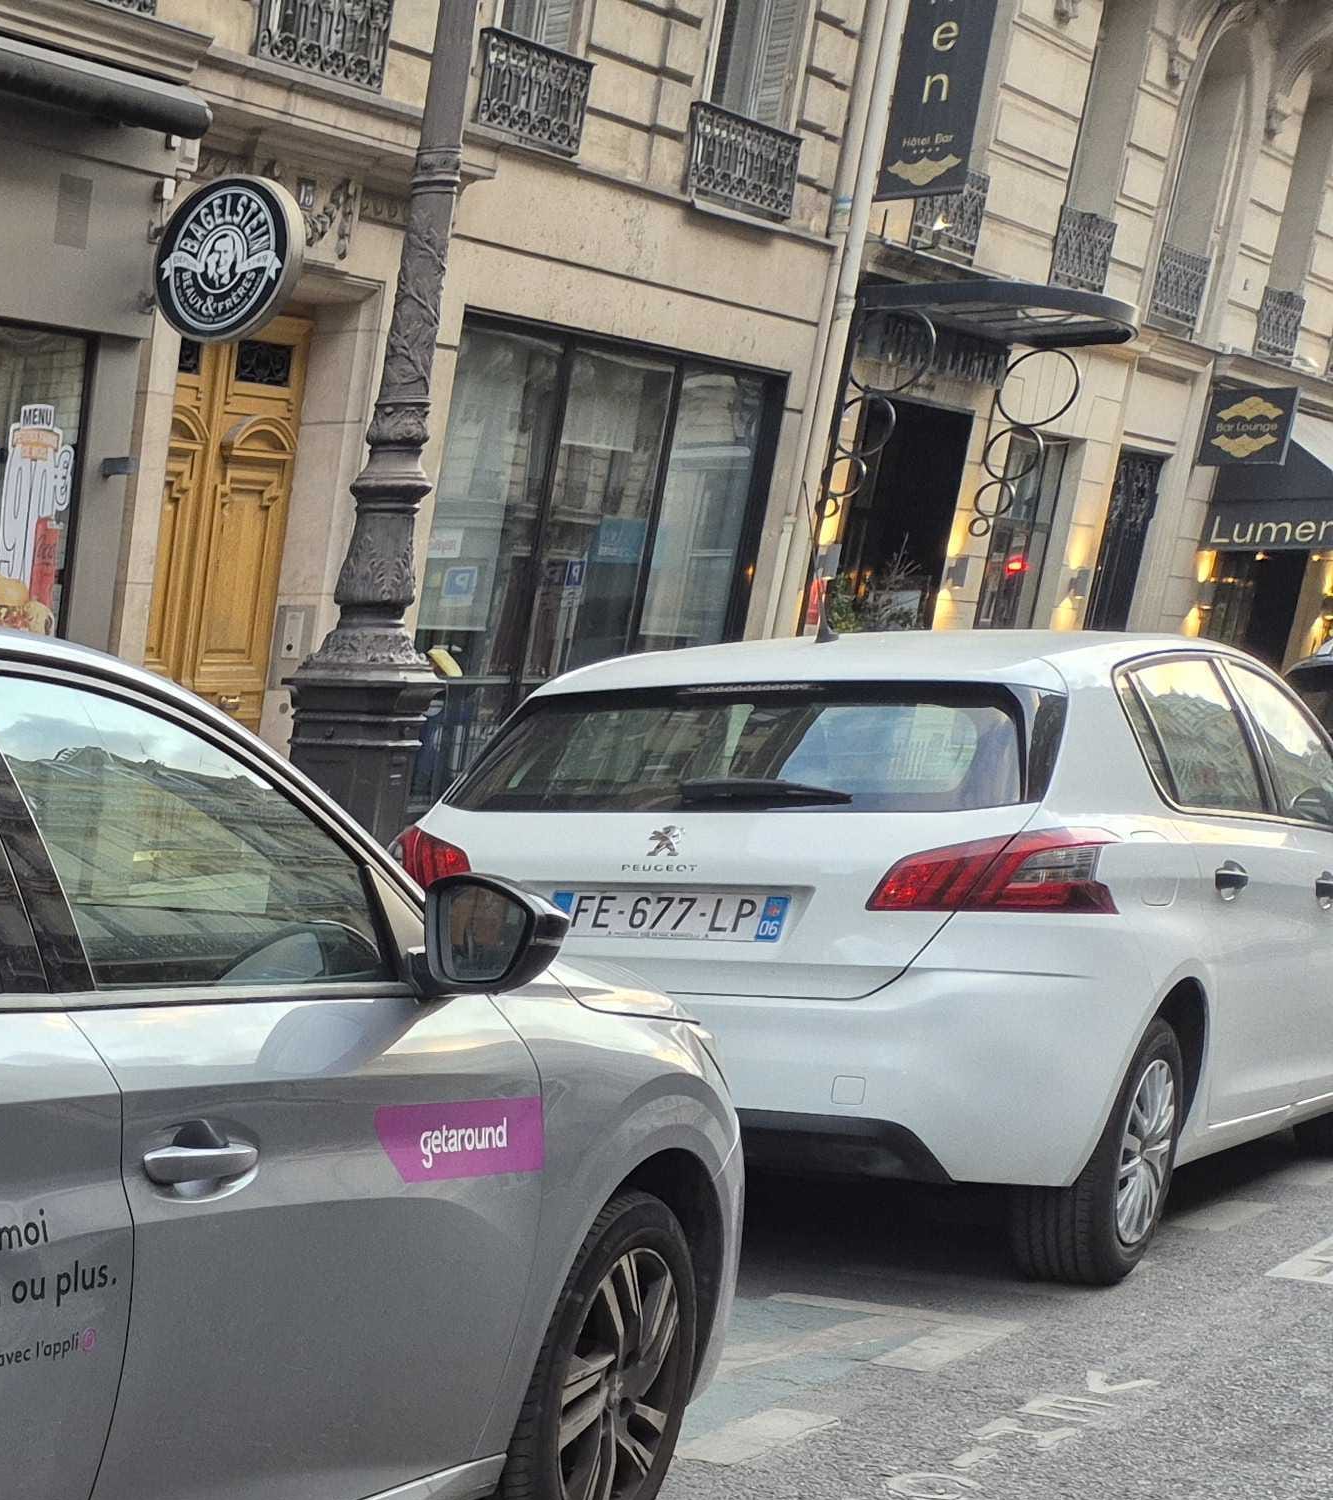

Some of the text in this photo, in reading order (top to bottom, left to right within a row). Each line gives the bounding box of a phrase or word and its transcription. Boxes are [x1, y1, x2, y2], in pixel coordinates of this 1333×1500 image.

[935, 133, 955, 144] Bar
[180, 194, 271, 255] BAGELSTEIN
[182, 271, 204, 310] BEAUX
[22, 408, 55, 427] MENU
[1216, 421, 1278, 433] Bar Lounge
[621, 864, 698, 873] PEUGEOT
[571, 895, 779, 937] FE-677-LP 06
[420, 1117, 508, 1168] getaround
[11, 1276, 46, 1304] ou
[56, 1259, 117, 1307] plus.
[36, 1331, 80, 1361] l'appli
